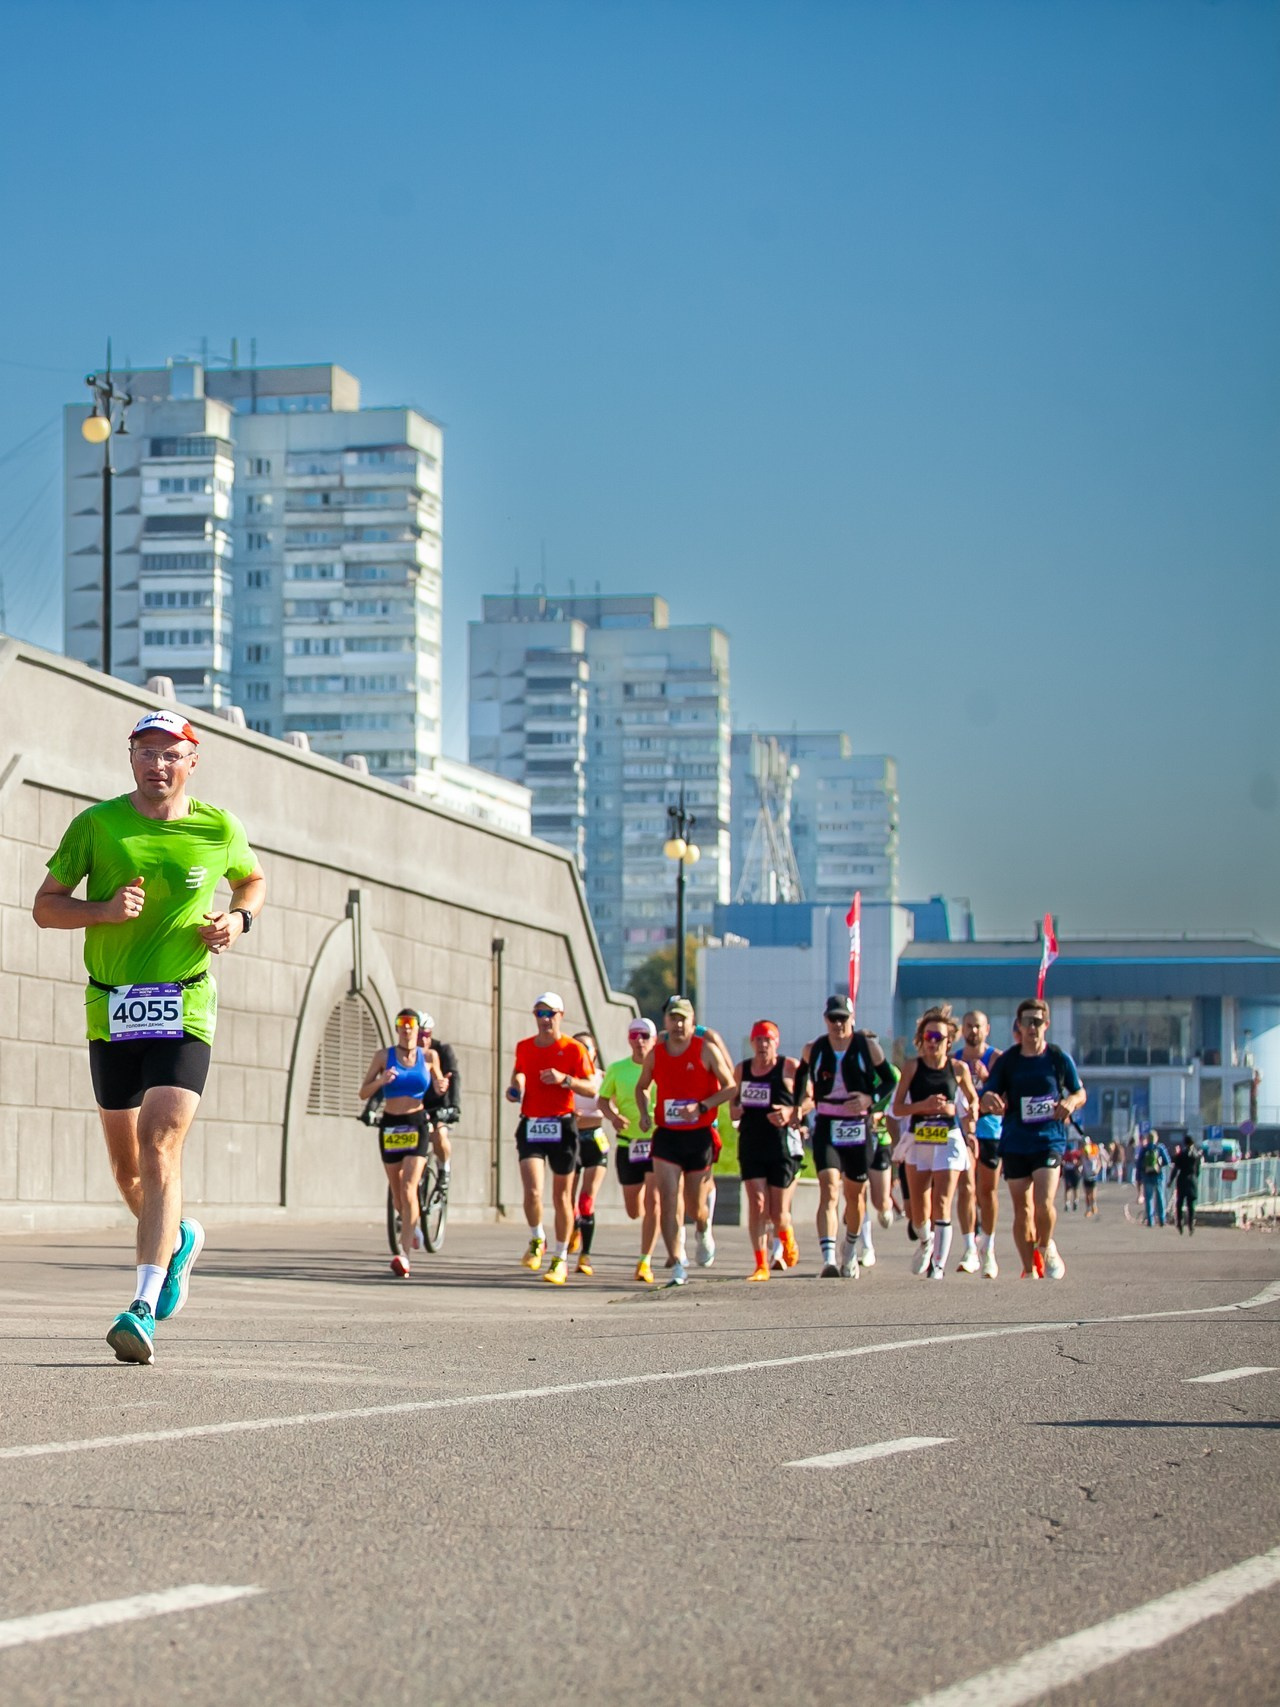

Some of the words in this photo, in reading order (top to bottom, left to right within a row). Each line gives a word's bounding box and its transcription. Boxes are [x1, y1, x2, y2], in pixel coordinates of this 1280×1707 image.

[113, 1000, 179, 1023] 4055
[742, 1089, 768, 1100] 4228
[1026, 1103, 1051, 1115] 3:29
[530, 1124, 558, 1134] 4163
[835, 1127, 860, 1138] 3:29
[916, 1127, 947, 1138] 4346
[385, 1133, 416, 1144] 4298
